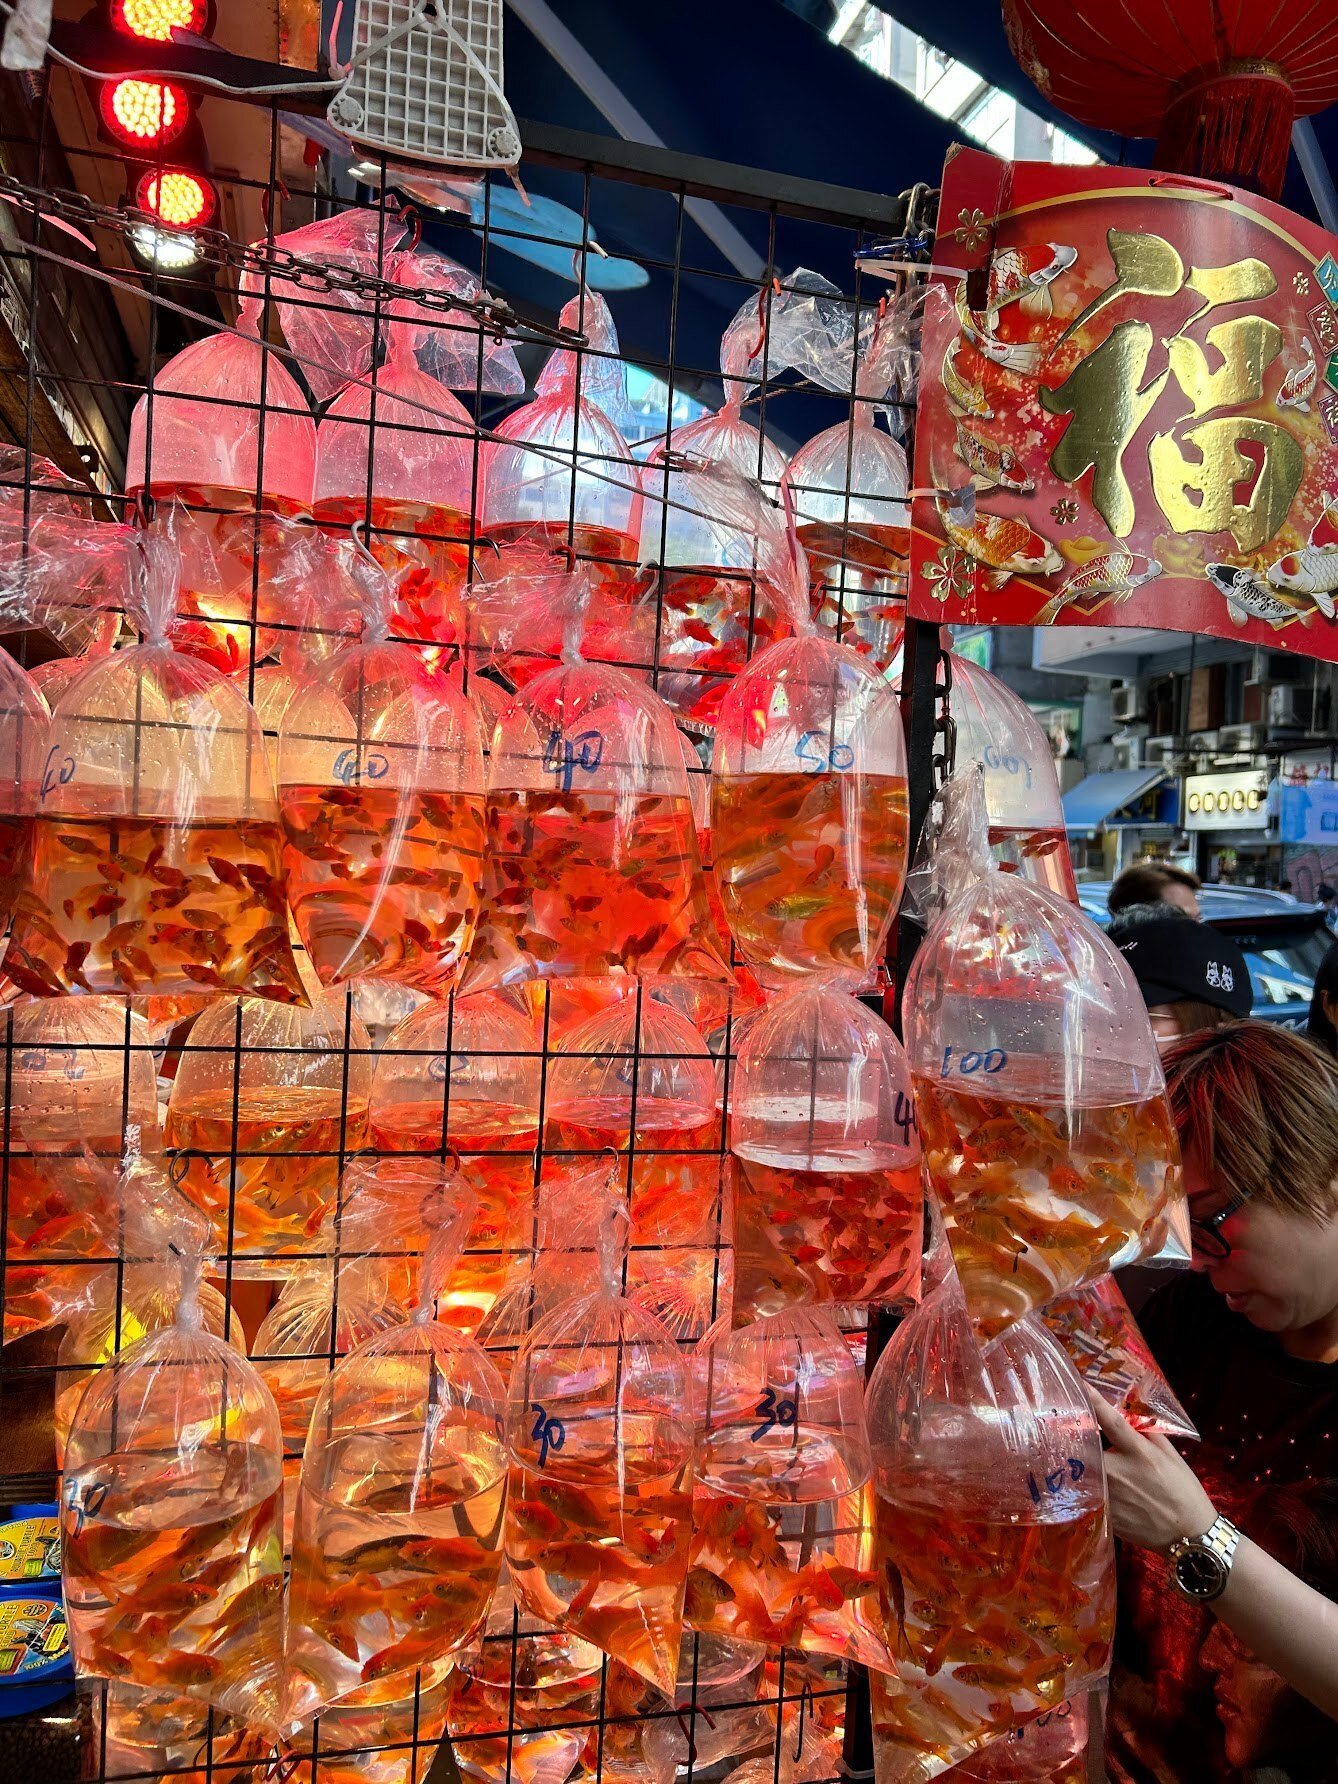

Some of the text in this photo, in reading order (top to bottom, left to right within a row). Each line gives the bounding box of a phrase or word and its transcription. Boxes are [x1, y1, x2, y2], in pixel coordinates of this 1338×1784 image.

[1038, 228, 1304, 554] 福
[542, 730, 603, 794] 40
[794, 730, 855, 774] 50
[940, 1046, 1008, 1079] 100
[531, 1403, 566, 1470] 30
[751, 1388, 797, 1443] 30
[65, 1478, 110, 1540] 30
[1028, 1458, 1085, 1505] 100
